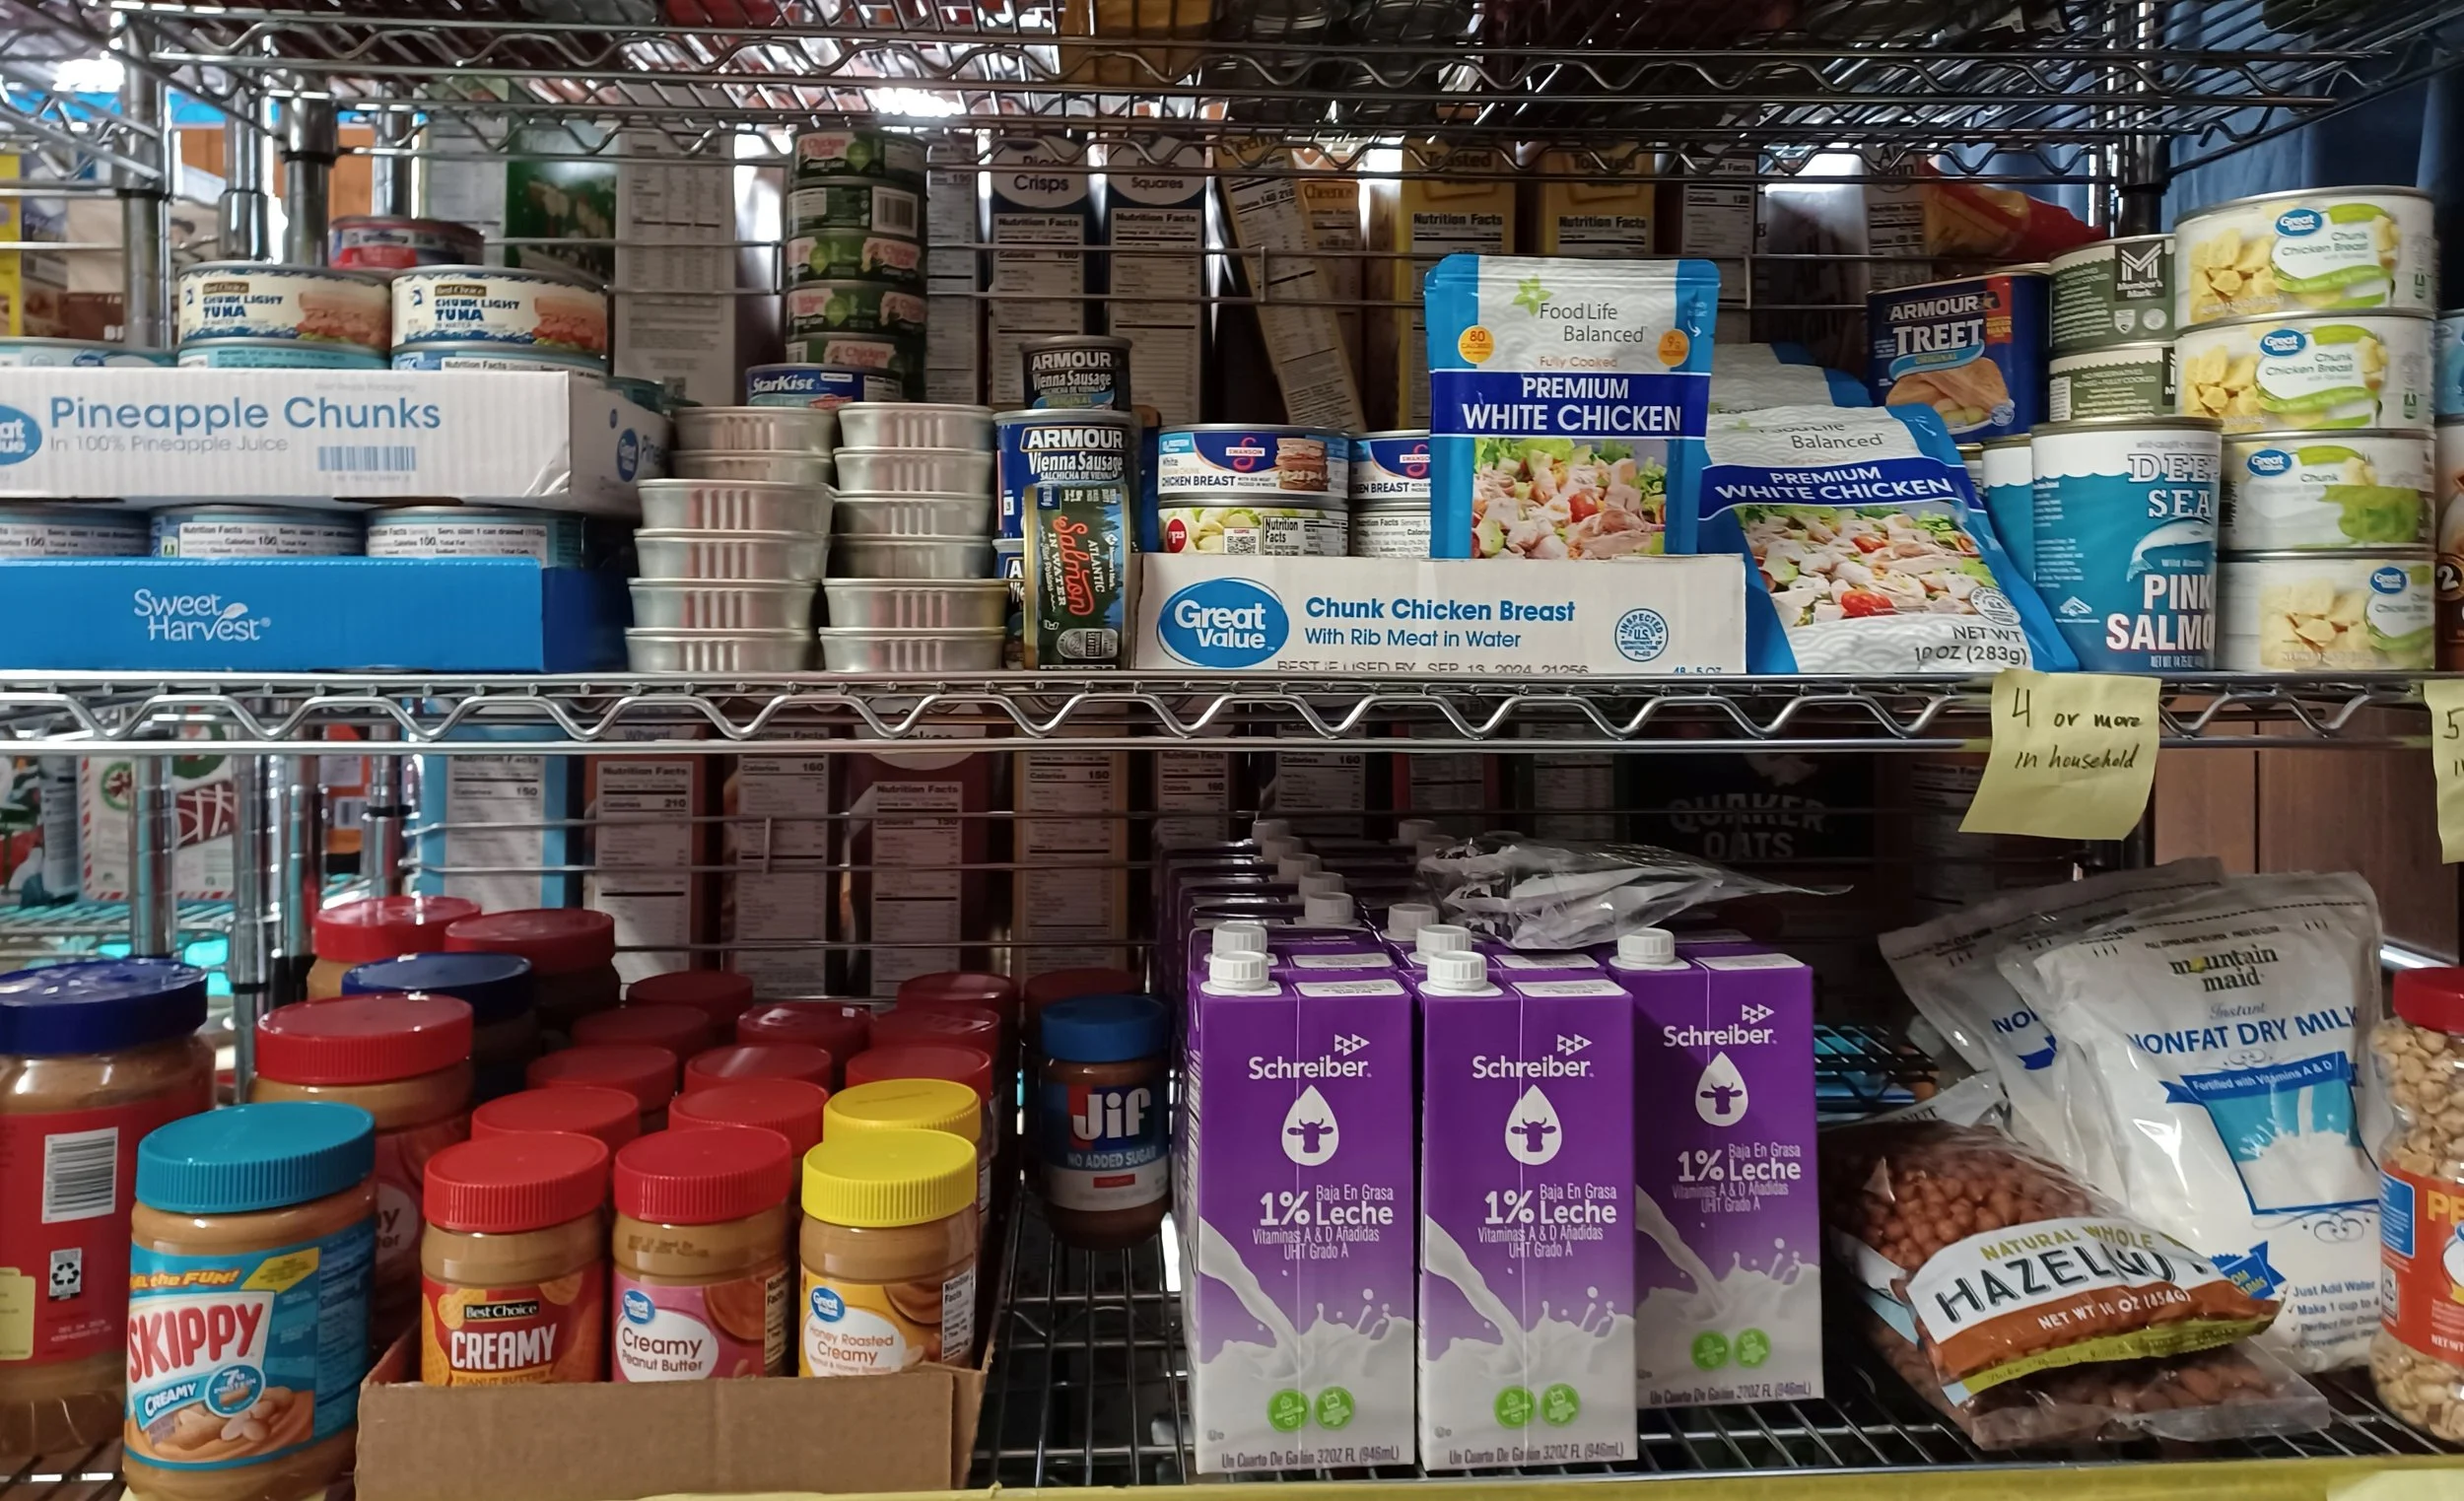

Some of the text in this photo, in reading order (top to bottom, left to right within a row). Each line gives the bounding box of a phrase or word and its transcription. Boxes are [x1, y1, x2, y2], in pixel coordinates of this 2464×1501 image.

[1426, 151, 1491, 168] Toasted
[1014, 174, 1069, 193] Crisps
[1131, 177, 1184, 189] Squares
[1413, 213, 1503, 226] Nutrition Facts
[2280, 213, 2315, 228] Great
[2331, 232, 2367, 241] Chunk
[435, 299, 520, 310] CHUNK LIGHT
[435, 309, 484, 321] TUNA
[1540, 303, 1617, 320] Food Life
[1889, 296, 1979, 321] ARMOUR
[1469, 331, 1486, 342] 80
[1564, 325, 1644, 343] Balanced
[1892, 319, 1983, 357] TREET
[1032, 352, 1112, 371] ARMOUR
[1540, 356, 1618, 369] Fully Cooked
[2316, 353, 2353, 362] Chunk
[751, 373, 815, 392] StarKist
[1522, 376, 1629, 399] PREMIUM
[50, 396, 441, 436] Pineapple Chunks
[1462, 403, 1681, 432] WHITE CHICKEN
[50, 435, 288, 454] In 100% Pineapple Juice
[1028, 430, 1123, 448] ARMOUR
[1791, 433, 1882, 449] Balanced
[1029, 451, 1123, 477] Vienna Sausage
[1770, 466, 1882, 485] PREMIUM
[1162, 475, 1236, 487] CHICKEN BREAST
[1714, 477, 1953, 501] WHITE CHICKEN
[2148, 489, 2212, 518] SEA
[1266, 516, 1298, 530] Nutrition
[1266, 531, 1286, 543] Facts
[1048, 532, 1066, 606] IN WATER
[1053, 515, 1095, 616] Salmon
[1087, 539, 1105, 592] ATLANTIC
[134, 588, 222, 616] Sweet
[2144, 575, 2212, 610] PINK
[1175, 600, 1266, 630] Great
[1306, 596, 1575, 622] Chunk Chicken Breast
[148, 613, 261, 642] Harvest
[1619, 613, 1663, 634] INSPECTED
[1953, 626, 2021, 643] NET WT
[2106, 613, 2217, 651] SALMO
[1197, 628, 1266, 649] Value
[1305, 628, 1521, 648] With Rib Meat in Water
[1277, 660, 1320, 671] BEST
[1343, 661, 1390, 672] USED
[1914, 646, 2027, 665] 10 OZ (283g)
[2012, 687, 2140, 728] 4 or more
[2443, 709, 2460, 740] 5
[2015, 750, 2037, 771] in
[2048, 744, 2139, 771] household
[603, 767, 687, 777] Nutrition Facts
[664, 798, 686, 808] 210
[1669, 792, 1825, 833] QUAKER
[1704, 831, 1794, 859] OATS
[2169, 944, 2279, 978] mountain
[2203, 969, 2261, 992] maid
[2210, 1001, 2265, 1020] Instant
[1664, 1024, 1773, 1047] Schreiber
[2241, 1018, 2288, 1047] DRY
[2299, 1005, 2358, 1035] MILK
[1249, 1055, 1368, 1079] Schreiber
[1472, 1055, 1590, 1079] Schreiber
[2193, 1061, 2333, 1090] Fortified with Vitamins A & D
[1073, 1088, 1151, 1140] Jif
[1067, 1145, 1156, 1168] NO ADDED SUGAR
[1677, 1150, 1802, 1183] 1% Leche
[1317, 1184, 1394, 1203] Baja En Grasa
[1260, 1191, 1394, 1226] 1% Leche
[1484, 1190, 1616, 1224] 1% Leche
[1253, 1226, 1379, 1244] Vitaminas A & D Añadidas
[1979, 1223, 2155, 1262] NATURAL WHOLE
[1284, 1243, 1348, 1260] UHT Grado A
[1935, 1242, 2209, 1324] HAZELNU
[2293, 1280, 2375, 1298] Just Add Water
[466, 1303, 537, 1319] Best Choice
[2037, 1310, 2070, 1331] NET
[2072, 1304, 2096, 1322] WT
[2118, 1295, 2141, 1314] OZ
[2144, 1286, 2192, 1309] (454G)
[128, 1303, 263, 1383] SKIPPY
[450, 1324, 558, 1369] CREAMY
[622, 1327, 703, 1358] Creamy
[810, 1326, 894, 1346] Honey Roasted
[622, 1349, 703, 1372] Peanut Butter
[817, 1341, 877, 1364] Creamy
[145, 1382, 196, 1417] CREAMY
[1237, 1453, 1266, 1467] Cuarto
[1270, 1452, 1283, 1467] De
[1345, 1448, 1355, 1462] FL
